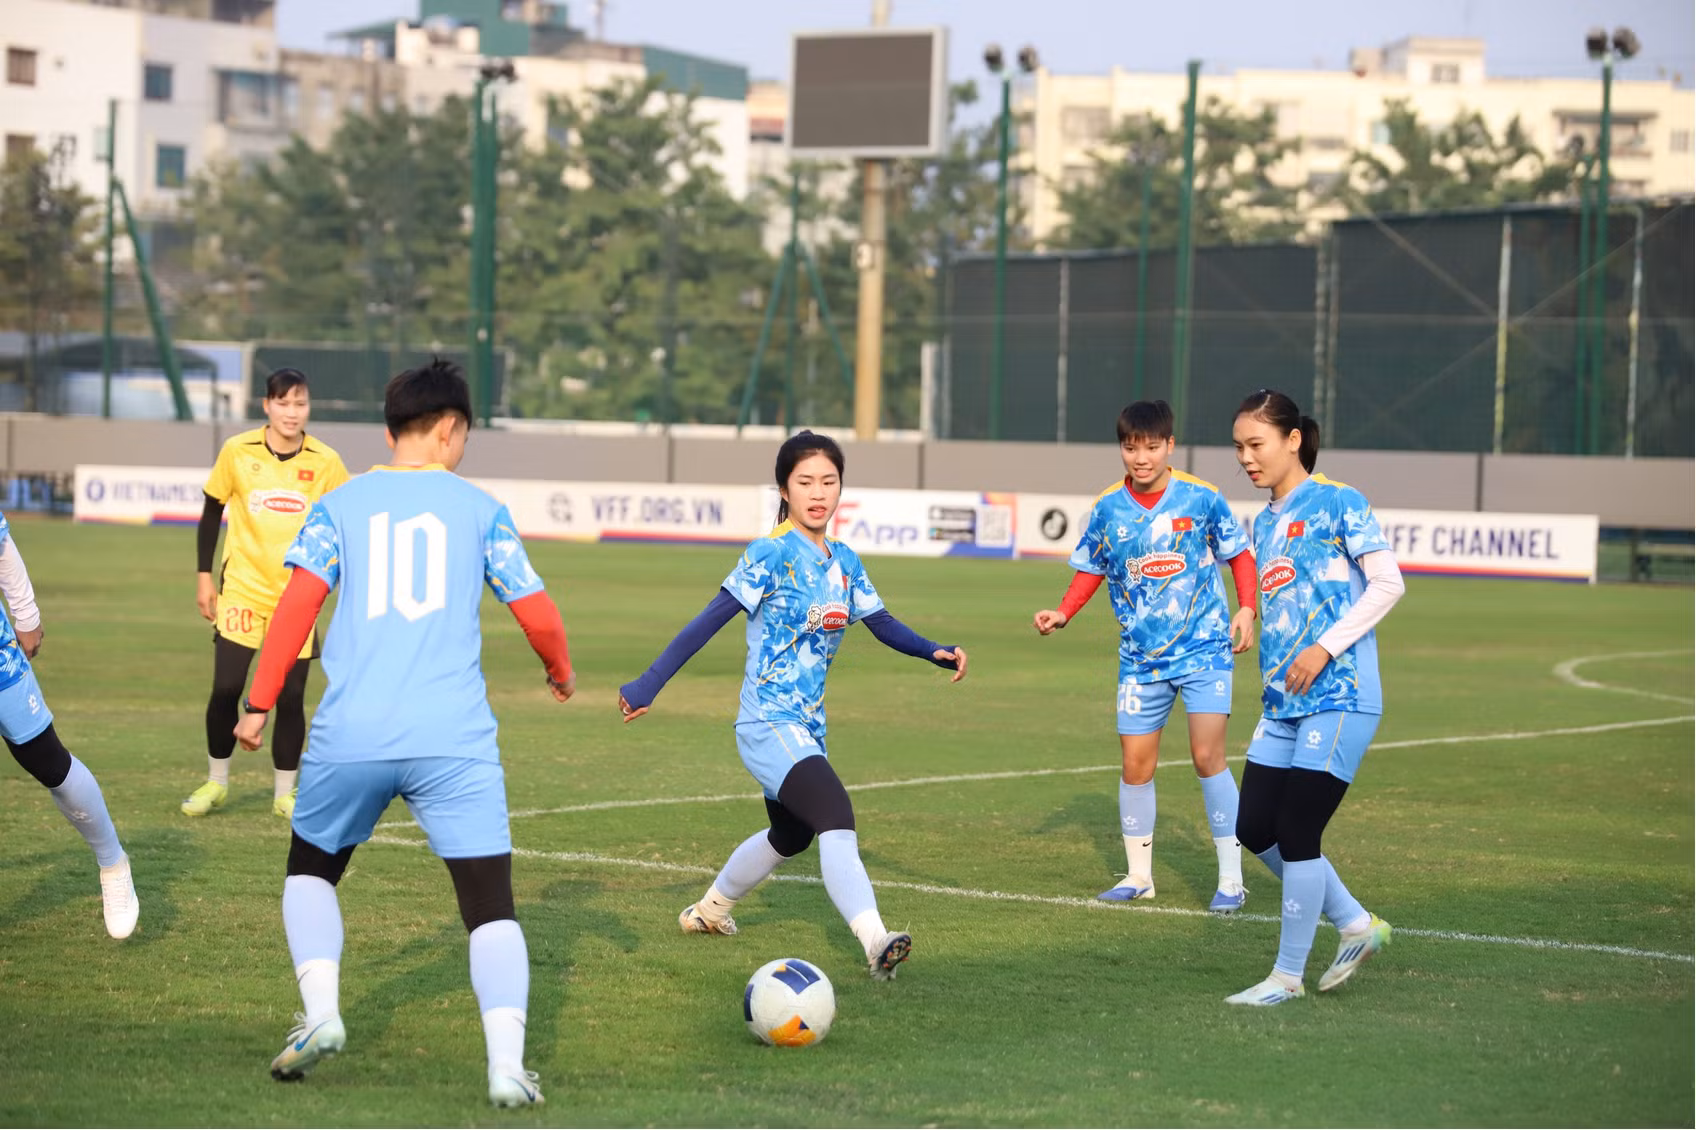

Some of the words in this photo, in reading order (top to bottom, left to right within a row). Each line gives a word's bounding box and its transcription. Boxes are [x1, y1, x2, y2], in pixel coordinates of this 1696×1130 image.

[851, 519, 919, 545] App
[1383, 524, 1422, 554] FF
[1432, 525, 1559, 559] CHANNEL
[367, 511, 447, 622] 10
[226, 607, 252, 633] 20
